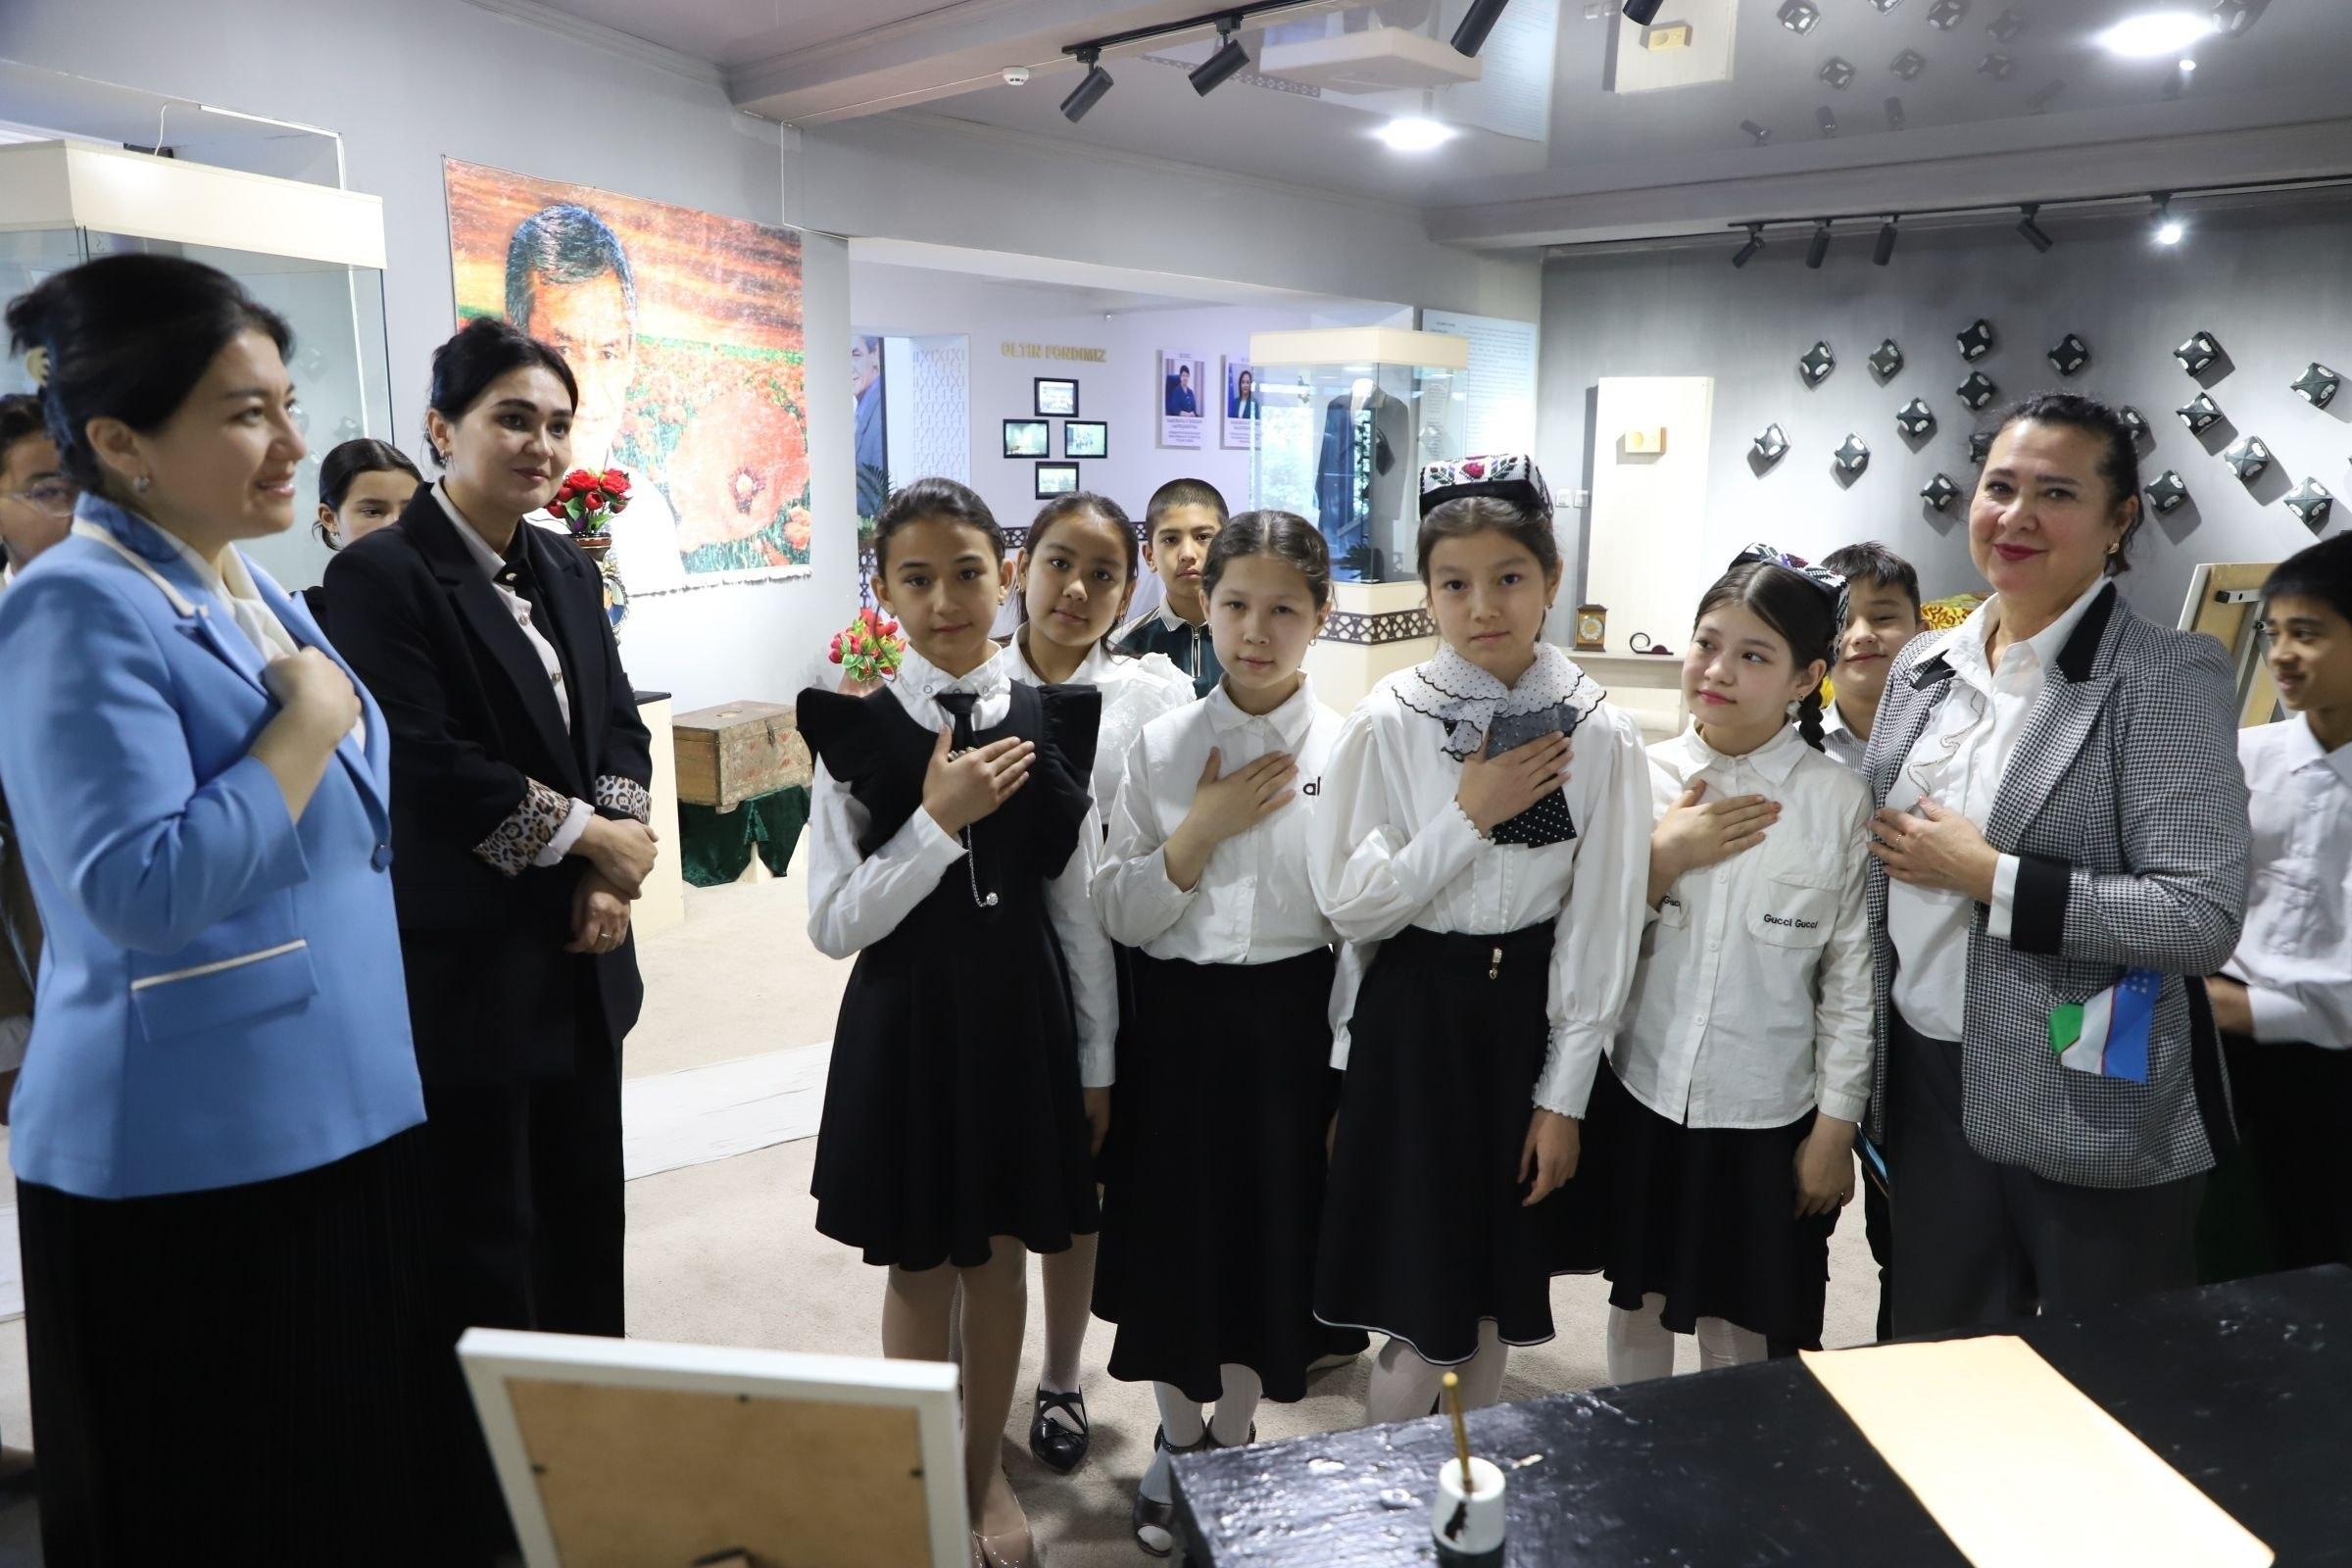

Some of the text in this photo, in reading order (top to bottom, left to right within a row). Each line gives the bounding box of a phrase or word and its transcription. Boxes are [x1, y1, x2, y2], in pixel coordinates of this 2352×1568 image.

[1002, 342, 1107, 363] OLTIN FONDIMIZ
[1764, 913, 1819, 929] Gucci Gucci
